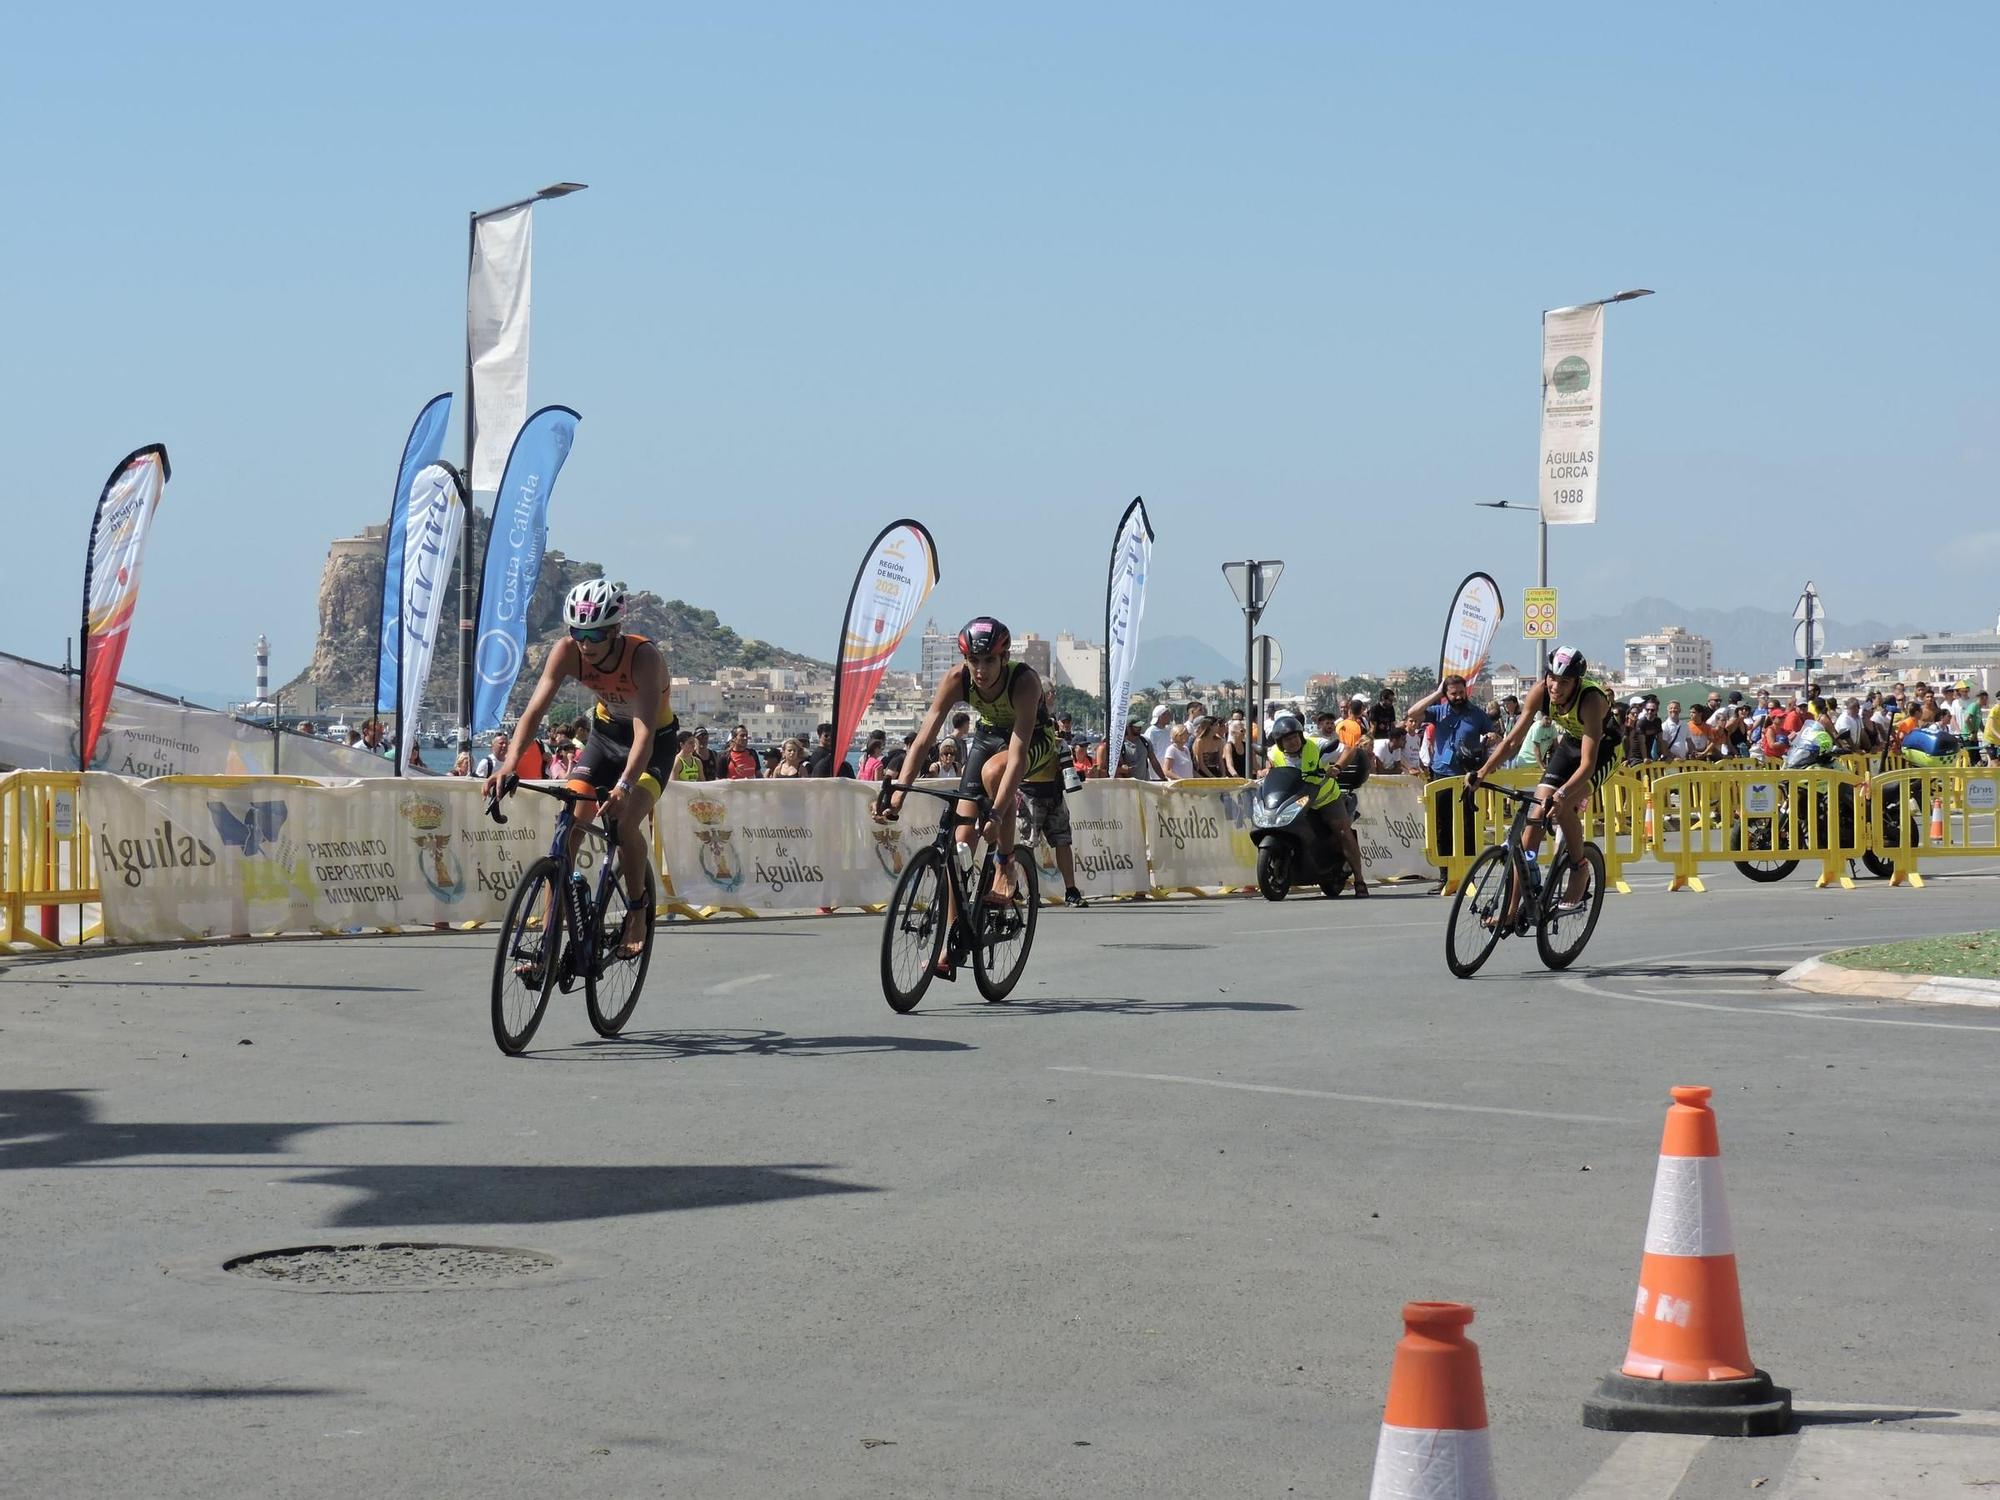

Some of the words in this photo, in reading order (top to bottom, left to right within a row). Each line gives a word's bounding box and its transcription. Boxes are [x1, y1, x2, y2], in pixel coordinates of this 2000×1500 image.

[1546, 450, 1594, 465] ÁGUILAS
[1550, 466, 1589, 479] LORCA
[1553, 489, 1584, 504] 1988
[496, 556, 520, 622] Costa
[508, 473, 540, 549] Cálida
[879, 560, 904, 573] REGIÓN
[877, 569, 887, 577] DE
[886, 571, 912, 586] MURCIA
[875, 578, 900, 597] 2023
[1463, 603, 1481, 613] REGIÓN
[1468, 611, 1487, 623] MURCIA
[1117, 680, 1131, 717] Murcia
[123, 728, 200, 754] Ayuntamiento
[153, 748, 168, 760] de
[742, 826, 814, 843] Ayuntamiento
[1156, 805, 1219, 850] Águilas
[1383, 809, 1426, 849] Águila
[461, 827, 537, 848] Ayuntamiento
[1092, 834, 1104, 848] de
[101, 820, 217, 888] Águilas
[307, 839, 388, 859] PATRONATO
[498, 845, 512, 863] de
[775, 842, 789, 858] de
[1361, 839, 1393, 868] guilas
[316, 862, 396, 882] DEPORTIVO
[1074, 847, 1134, 881] Águilas
[755, 856, 825, 893] Águilas
[325, 885, 404, 904] MUNICIPAL
